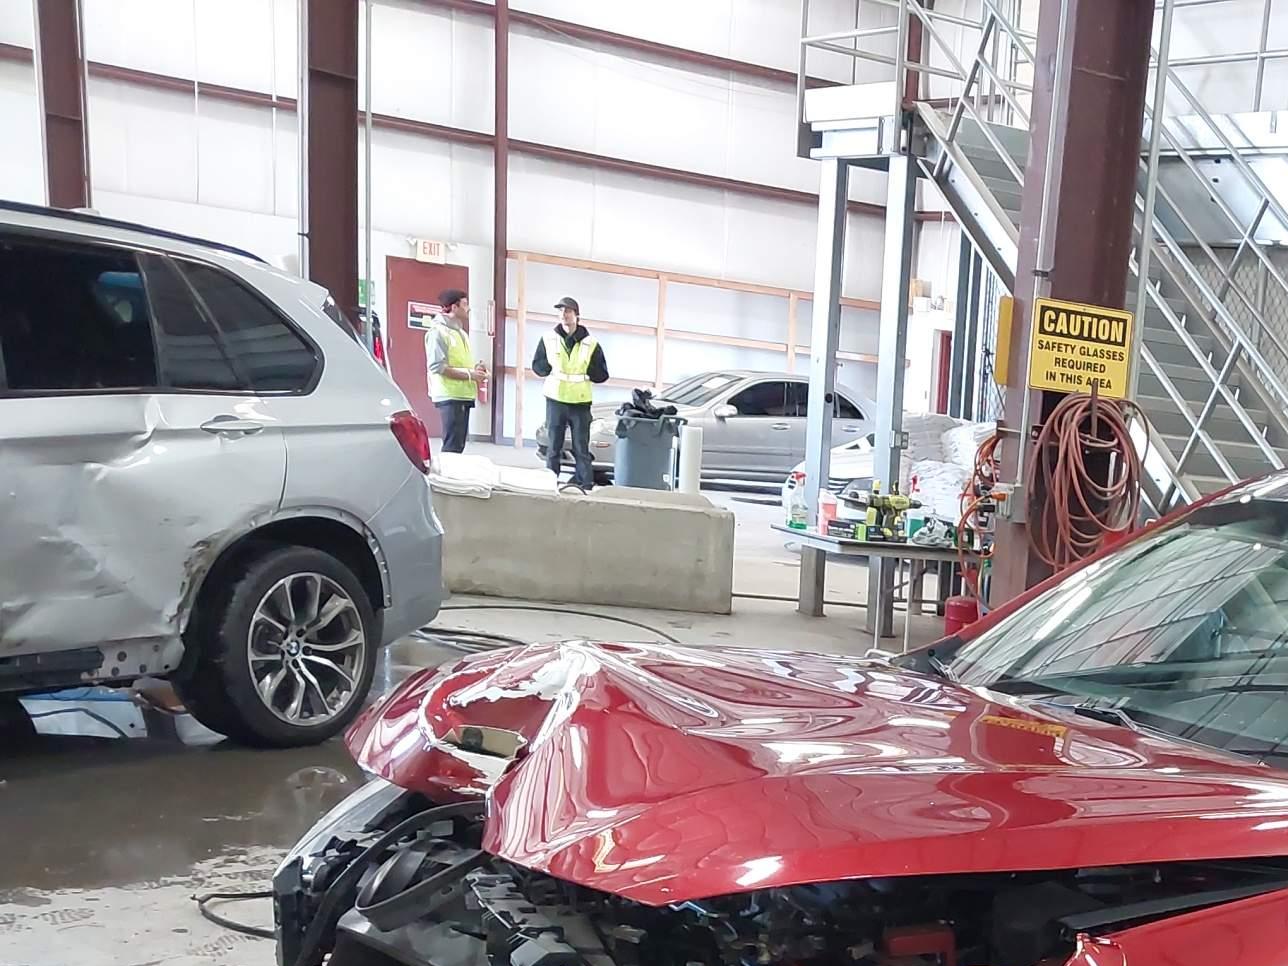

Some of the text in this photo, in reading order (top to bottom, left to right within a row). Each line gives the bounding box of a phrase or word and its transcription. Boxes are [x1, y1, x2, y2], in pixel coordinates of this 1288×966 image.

[422, 241, 440, 256] EXIT
[1043, 310, 1124, 342] CAUTION
[1038, 340, 1125, 361] SAFETY GLASSES
[1054, 357, 1106, 373] REQUIRED
[1046, 371, 1056, 381] IN
[1060, 372, 1083, 385] THIS
